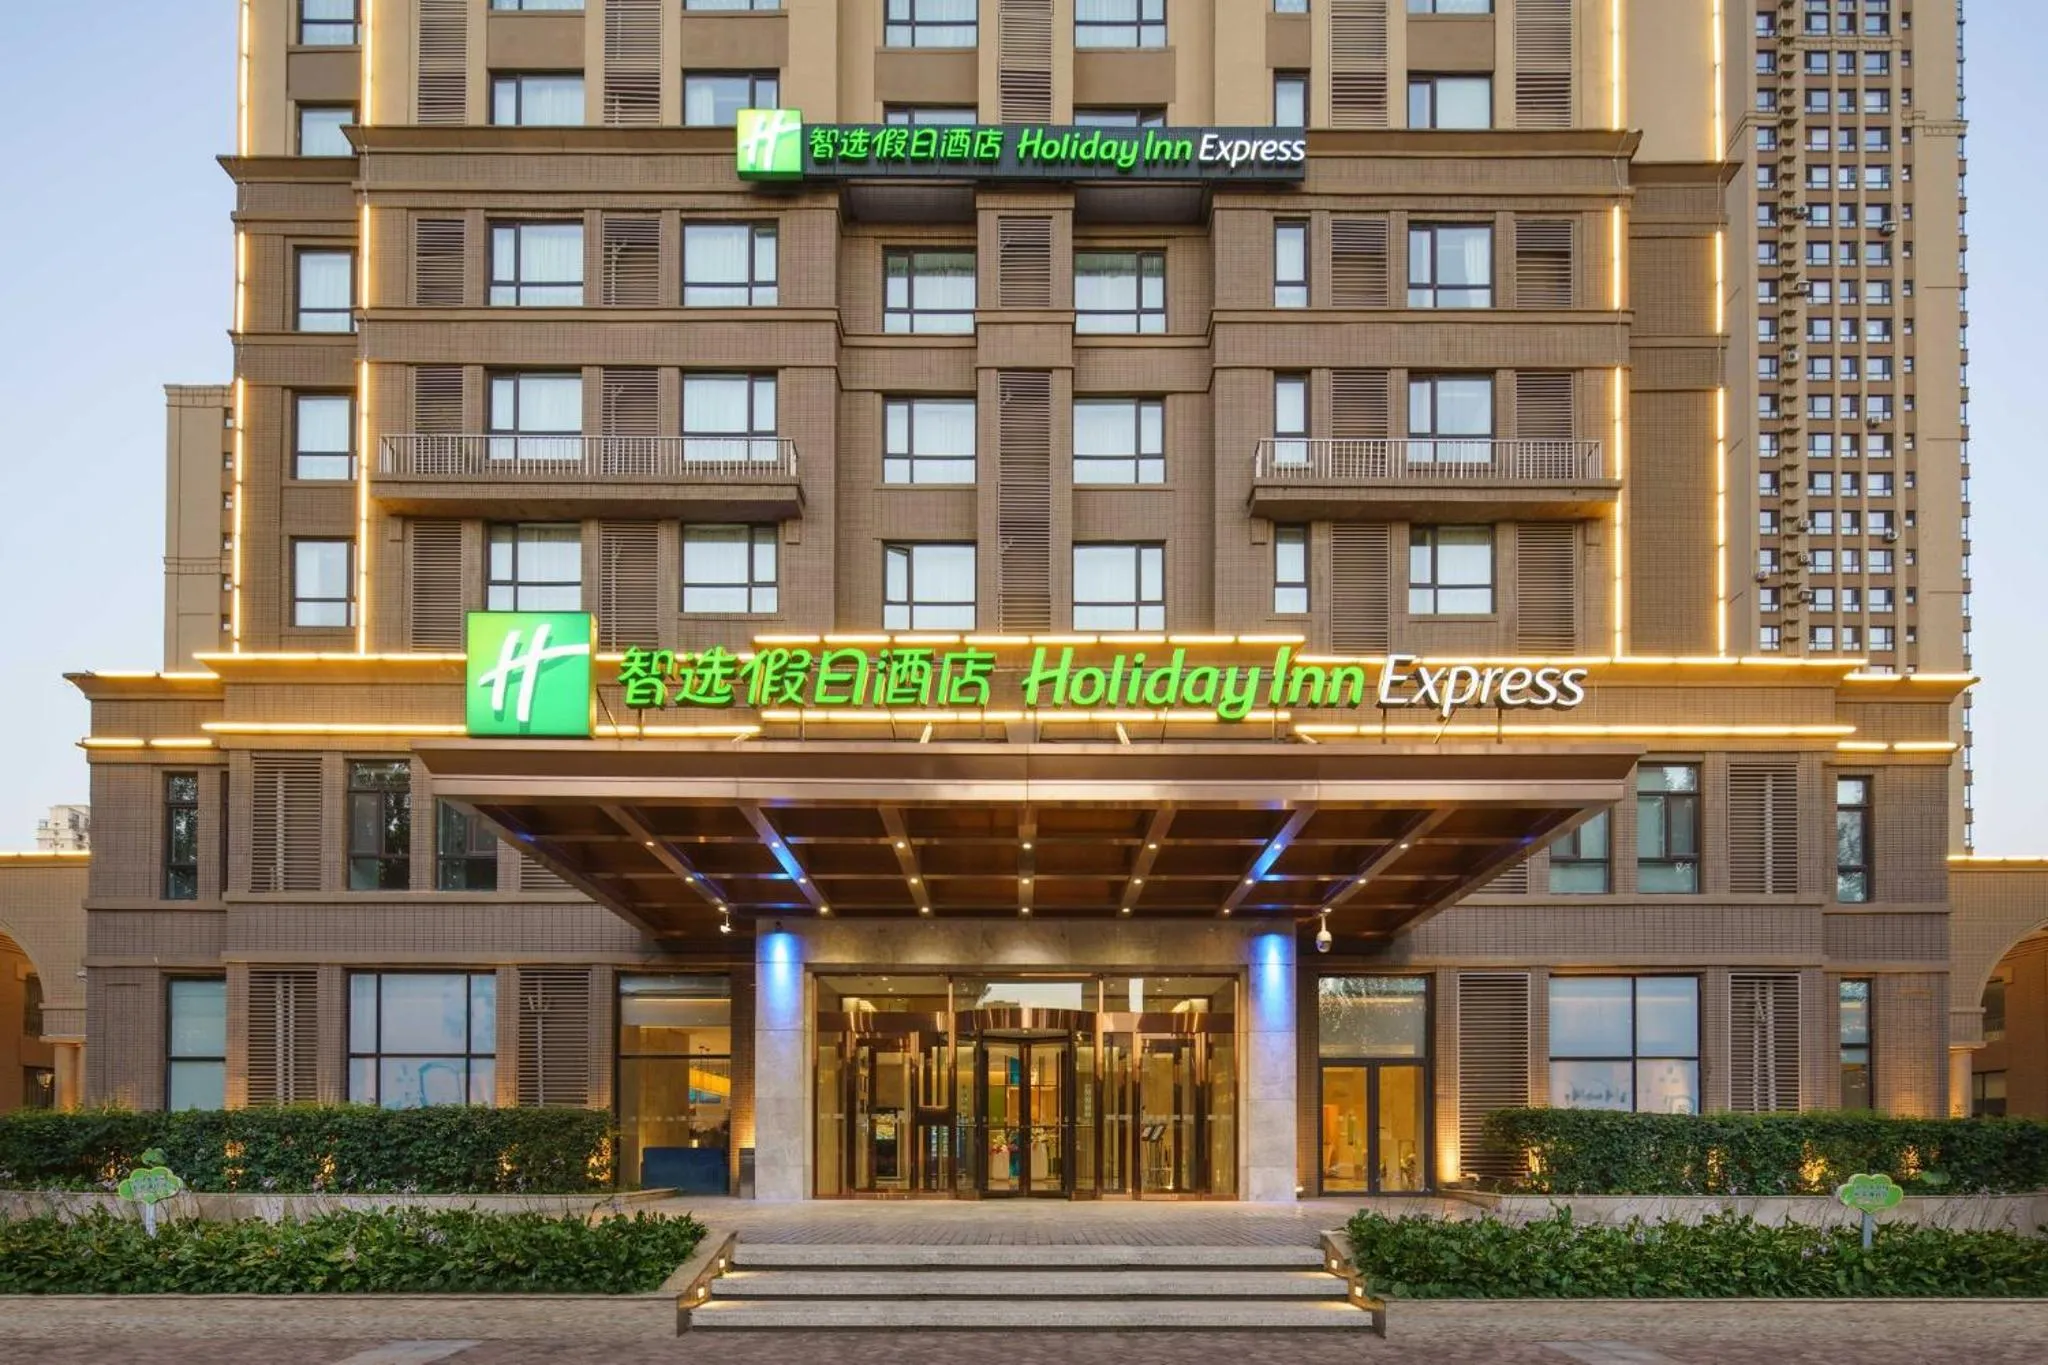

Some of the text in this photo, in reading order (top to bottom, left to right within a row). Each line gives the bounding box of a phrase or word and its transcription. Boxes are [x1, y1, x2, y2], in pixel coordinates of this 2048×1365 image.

[810, 128, 1004, 160] 智选假日酒店
[1018, 128, 1306, 168] Holiday Inn Express
[618, 646, 996, 708] 智选假日酒店
[1022, 646, 1588, 720] Holiday Inn Express
